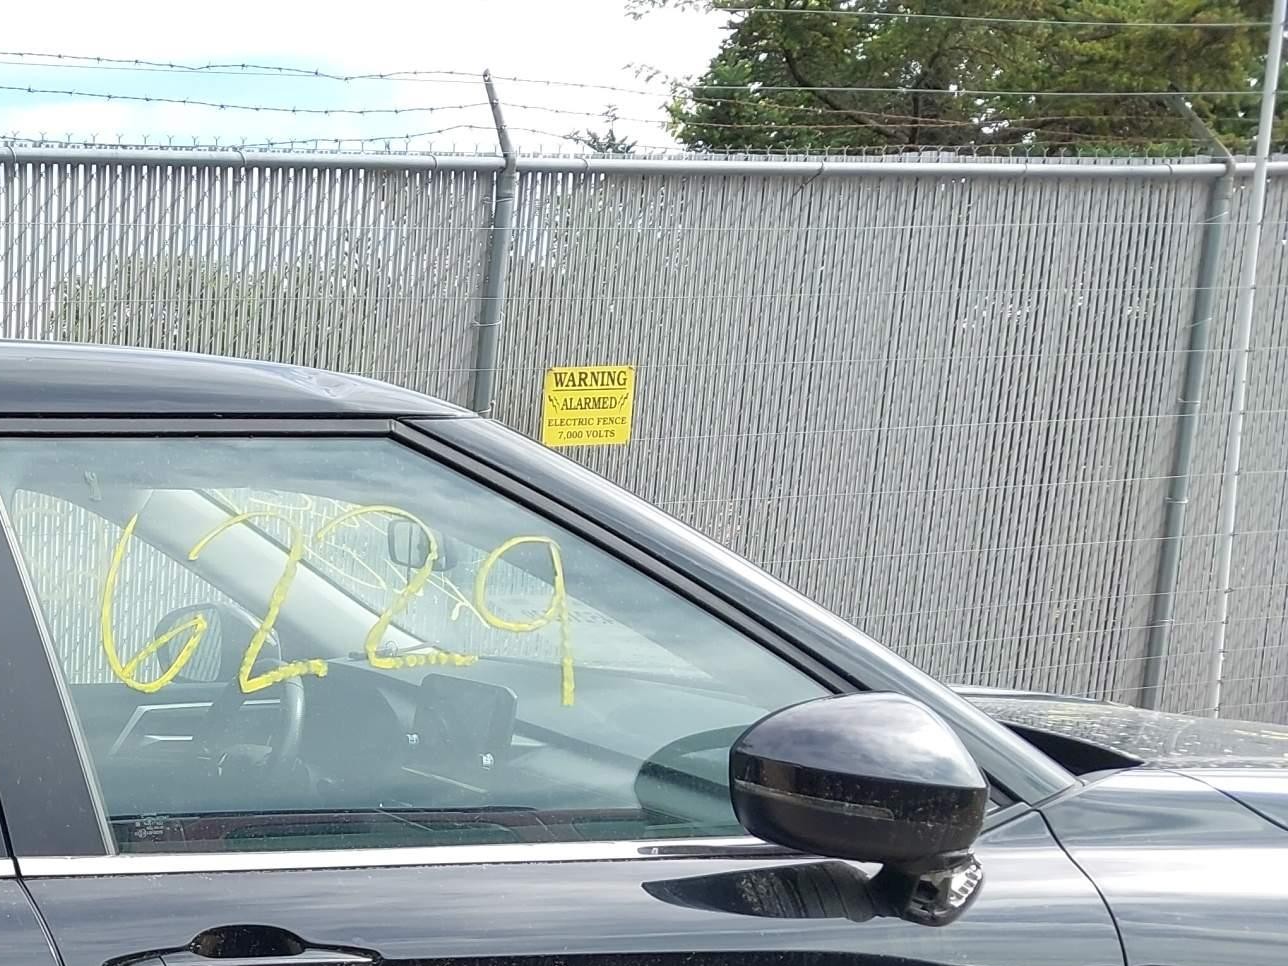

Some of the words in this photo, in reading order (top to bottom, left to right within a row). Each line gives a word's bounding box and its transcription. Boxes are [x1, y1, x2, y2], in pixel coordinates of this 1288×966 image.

[553, 370, 628, 388] WARNING
[560, 396, 618, 411] ALARMED
[547, 417, 595, 428] ELECTRIC
[596, 416, 628, 426] FENCE
[558, 430, 583, 441] 7,000
[585, 429, 616, 439] VOLTS
[101, 504, 577, 707] 6229
